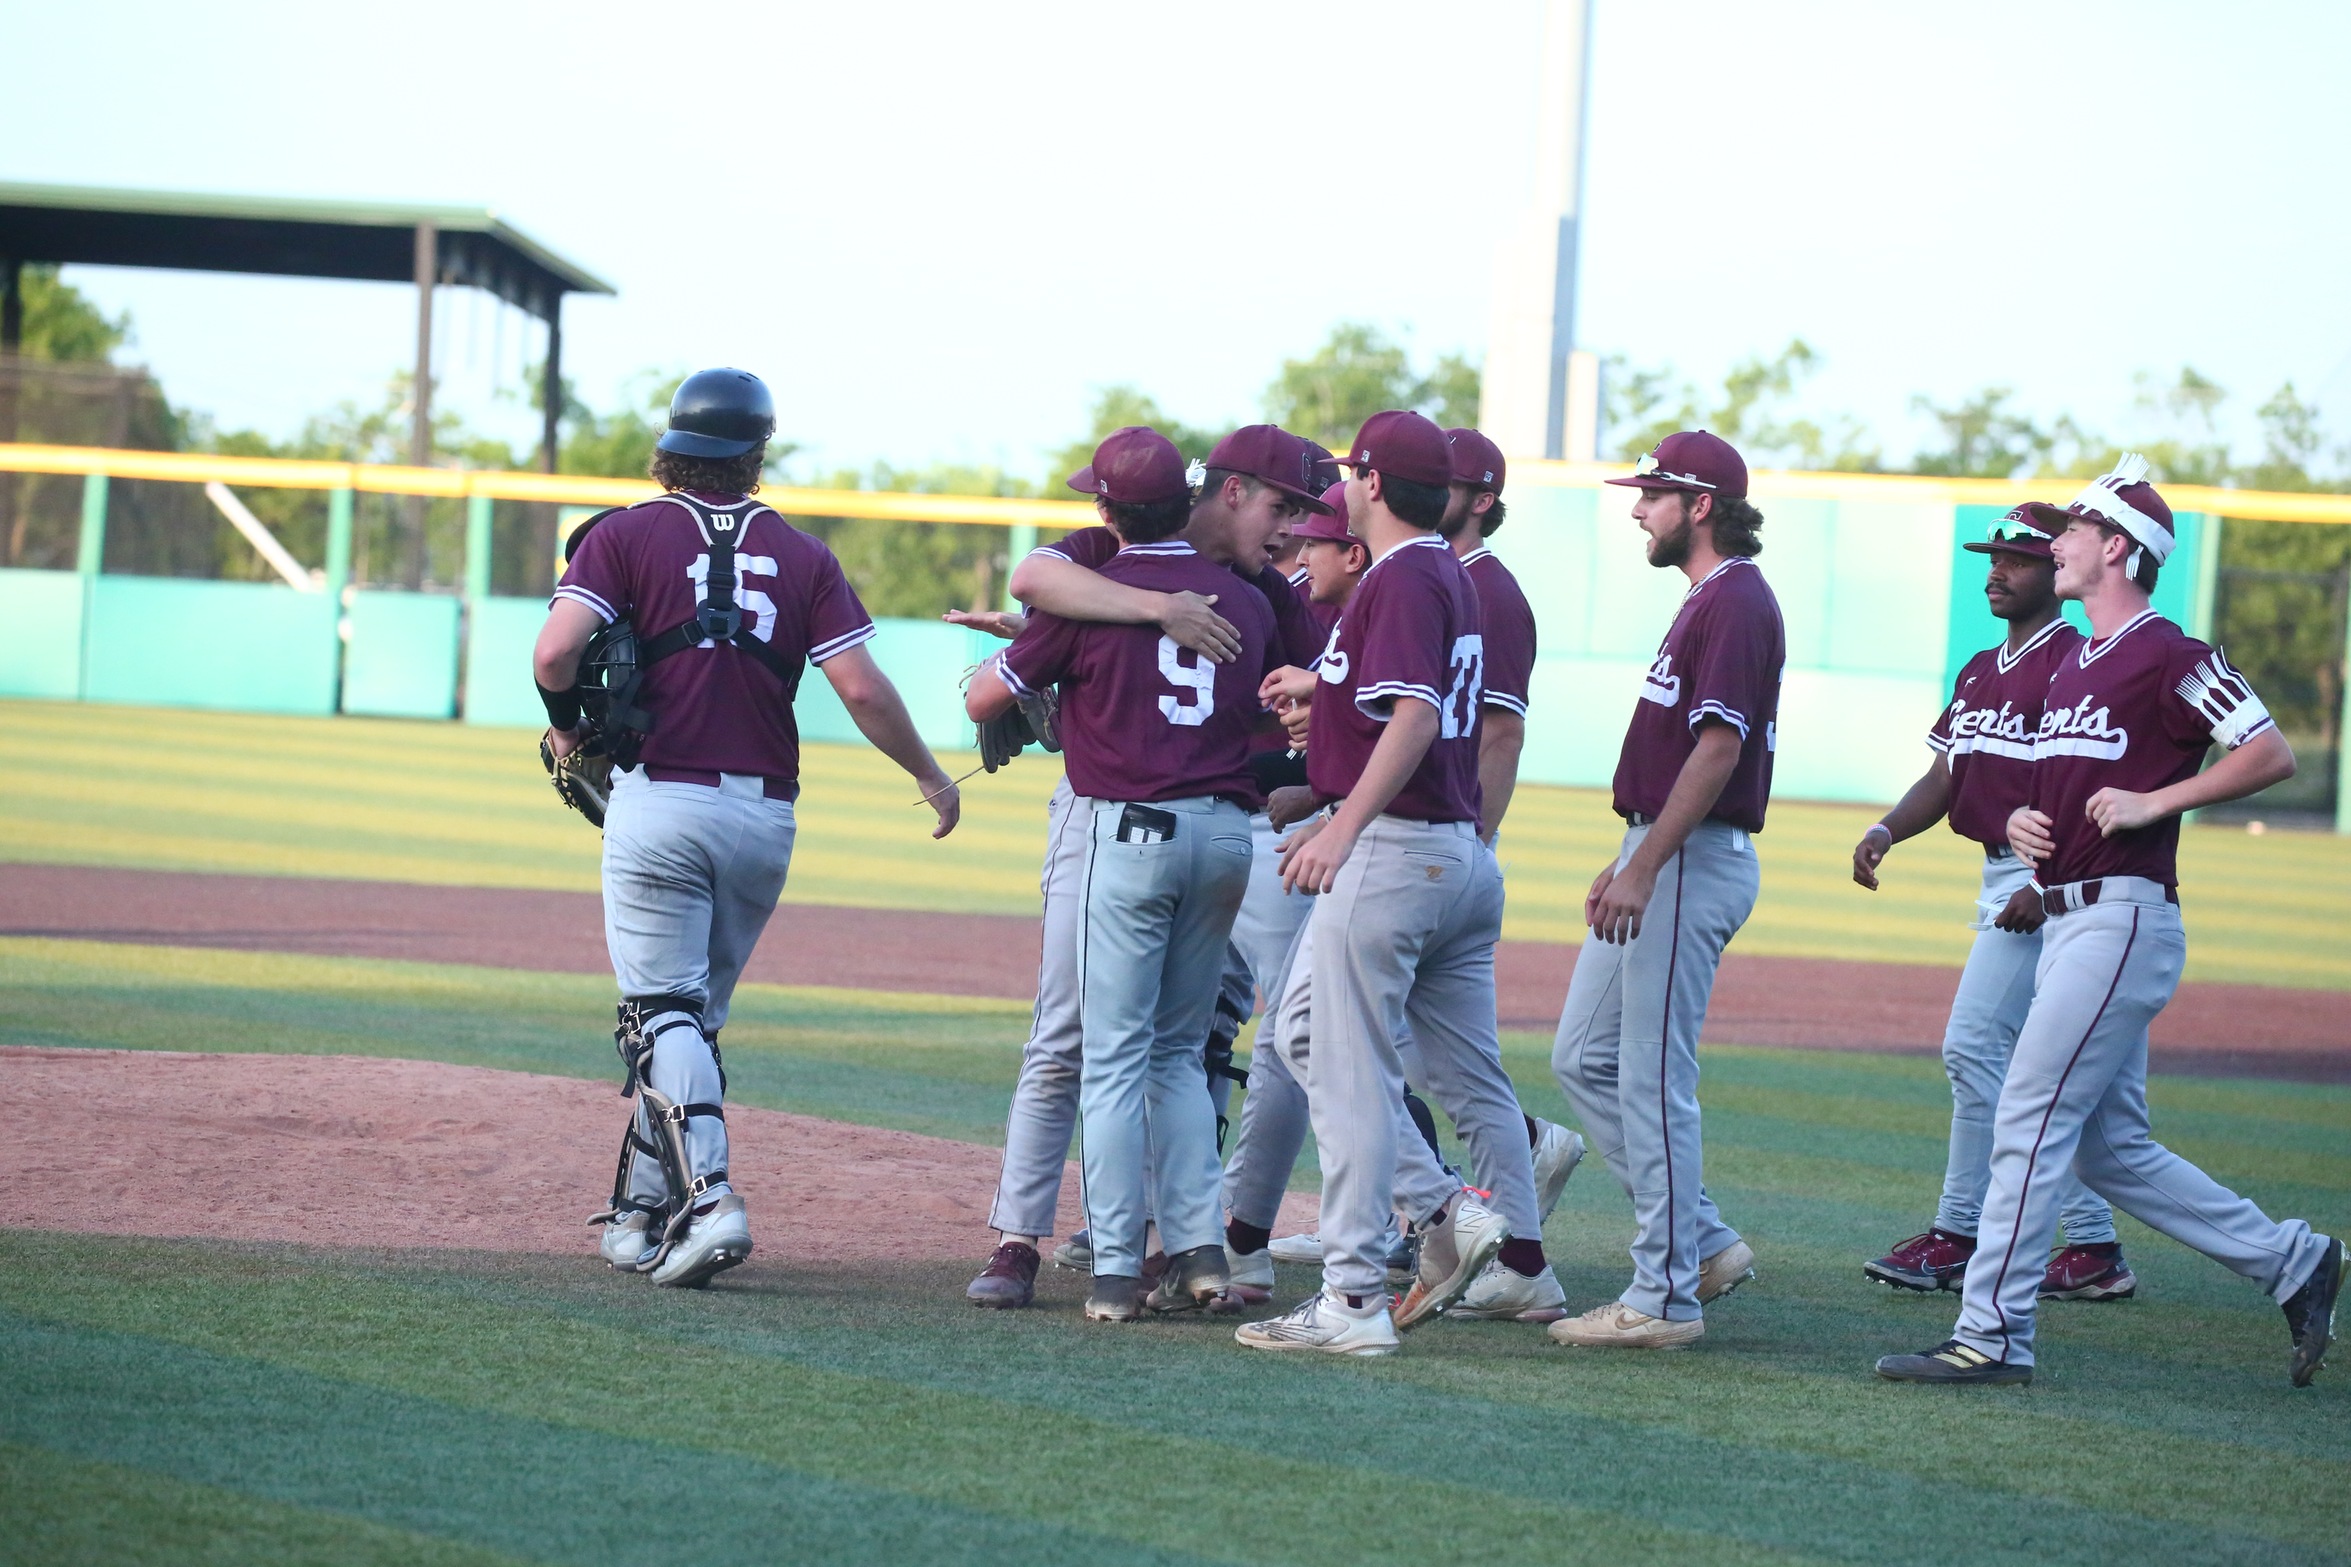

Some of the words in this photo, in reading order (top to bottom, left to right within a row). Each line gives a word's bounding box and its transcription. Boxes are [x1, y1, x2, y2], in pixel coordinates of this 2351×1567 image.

[1158, 633, 1216, 726] 9
[1947, 698, 2039, 764] Gents
[2038, 694, 2127, 760] ents
